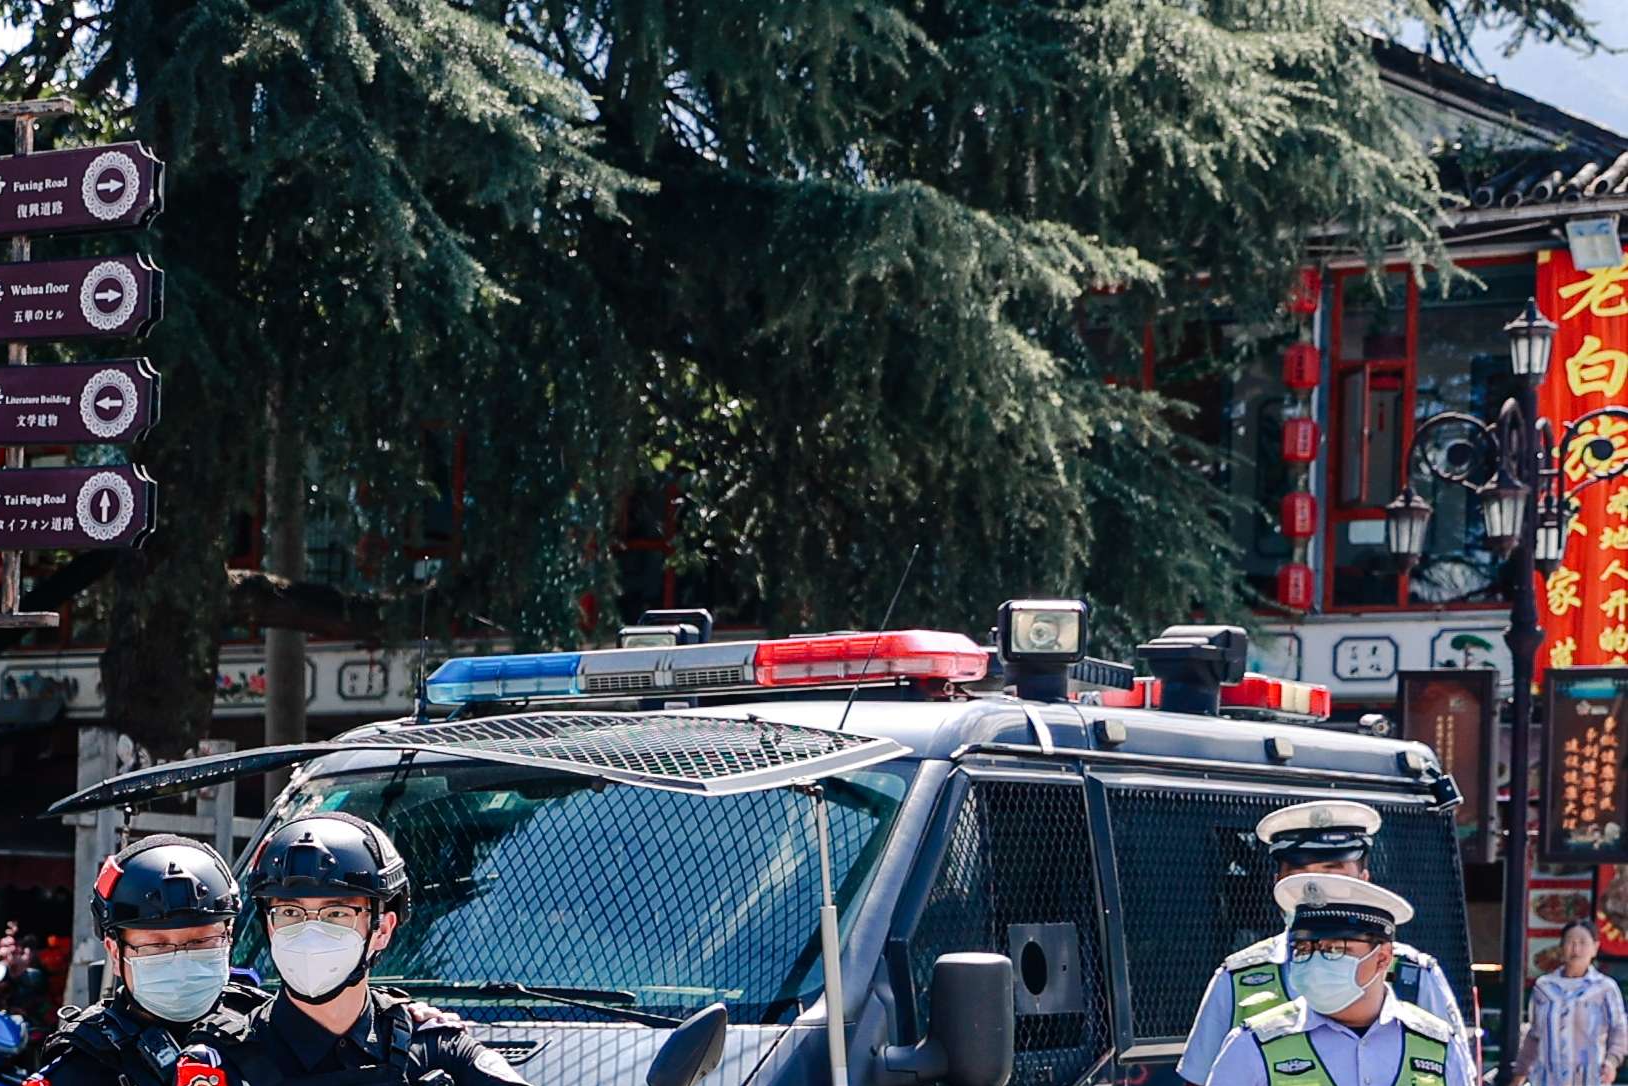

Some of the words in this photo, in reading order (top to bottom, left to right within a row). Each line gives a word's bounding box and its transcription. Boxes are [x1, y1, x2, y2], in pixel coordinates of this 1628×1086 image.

[13, 180, 44, 194] Fuxing
[45, 177, 68, 189] Road
[10, 284, 44, 297] Wuhua
[45, 282, 70, 295] floor
[41, 394, 71, 406] Building
[4, 494, 19, 506] Tai
[19, 494, 42, 508] Fung
[43, 493, 67, 505] Road
